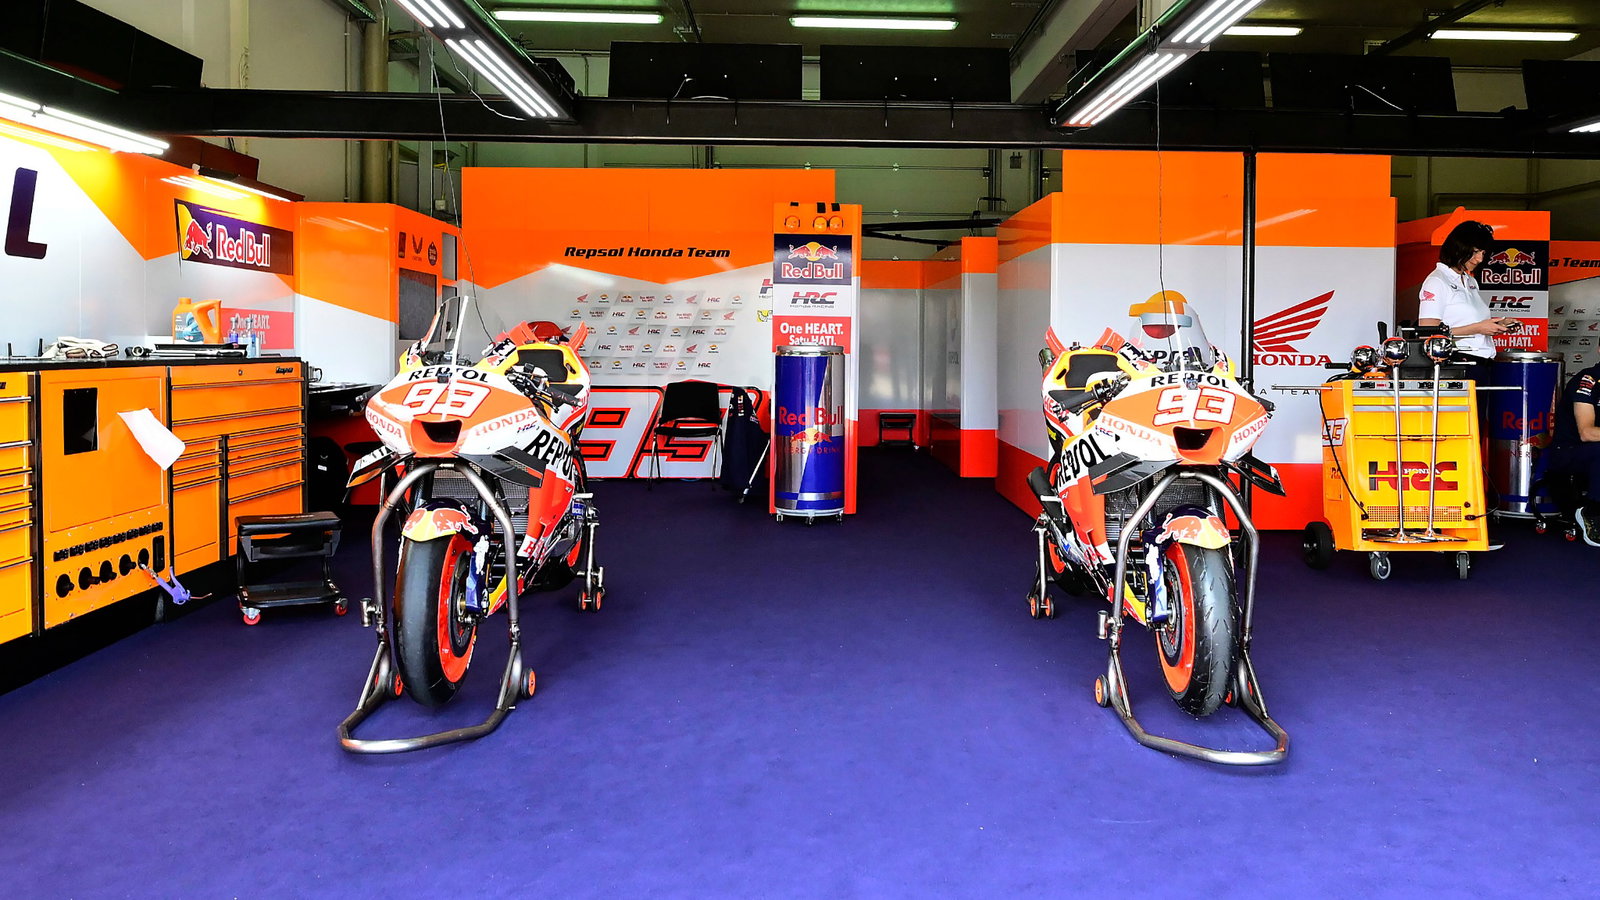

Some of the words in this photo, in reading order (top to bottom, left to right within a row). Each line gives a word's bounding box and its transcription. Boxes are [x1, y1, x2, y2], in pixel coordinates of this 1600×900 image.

[564, 246, 623, 259] Repsol
[627, 247, 683, 258] Honda
[687, 247, 730, 258] Team
[781, 262, 812, 278] Red
[813, 262, 843, 279] Bull
[1481, 268, 1511, 284] Red
[1511, 268, 1541, 285] Bull
[791, 291, 837, 304] HRC
[1489, 296, 1533, 308] HRC
[780, 322, 803, 334] One
[805, 323, 844, 335] HEART.
[1508, 337, 1534, 347] HATI.
[1153, 386, 1236, 426] 93
[366, 410, 402, 438] HONDA
[475, 409, 537, 436] HONDA
[814, 406, 843, 426] Bull
[1101, 415, 1162, 446] HONDA
[1233, 416, 1268, 444] HONDA
[1369, 461, 1458, 491] HRC
